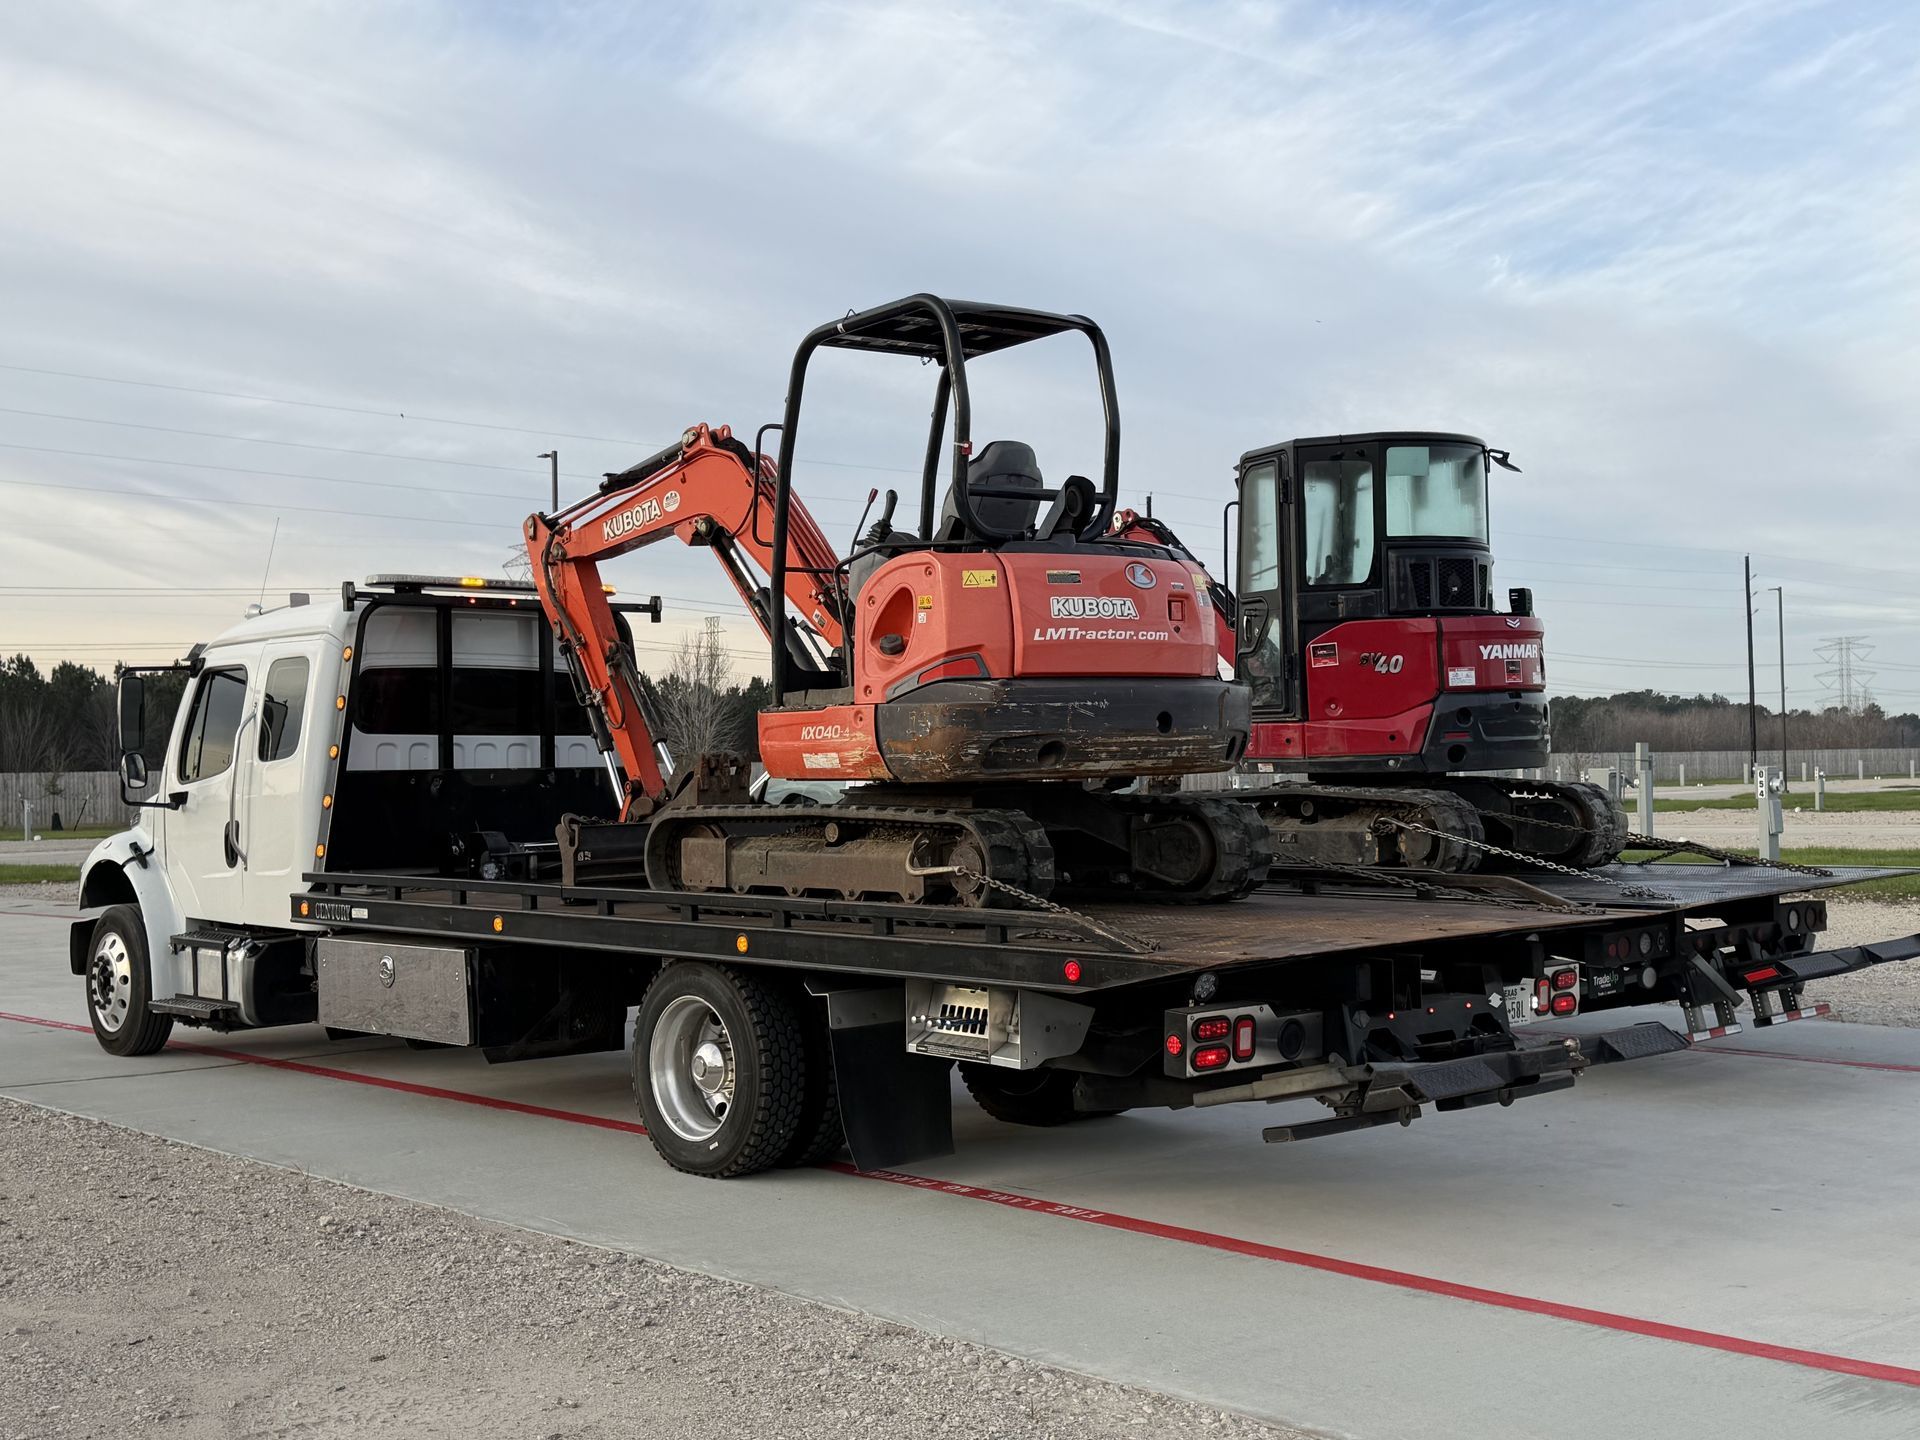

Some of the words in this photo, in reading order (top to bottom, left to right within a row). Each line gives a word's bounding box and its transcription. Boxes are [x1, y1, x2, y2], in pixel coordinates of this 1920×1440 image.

[602, 497, 663, 541] KUBOTA
[1051, 597, 1138, 619] KUBOTA
[1033, 627, 1169, 641] LMTractor.com
[1478, 644, 1538, 660] YANMAR
[800, 724, 850, 741] KX040-4
[315, 902, 351, 921] CENTURY
[1504, 988, 1518, 998] EXAS
[854, 1169, 939, 1187] PARKIN
[942, 1184, 976, 1194] NO
[980, 1192, 1037, 1207] LANE
[1045, 1204, 1104, 1219] FIRE
